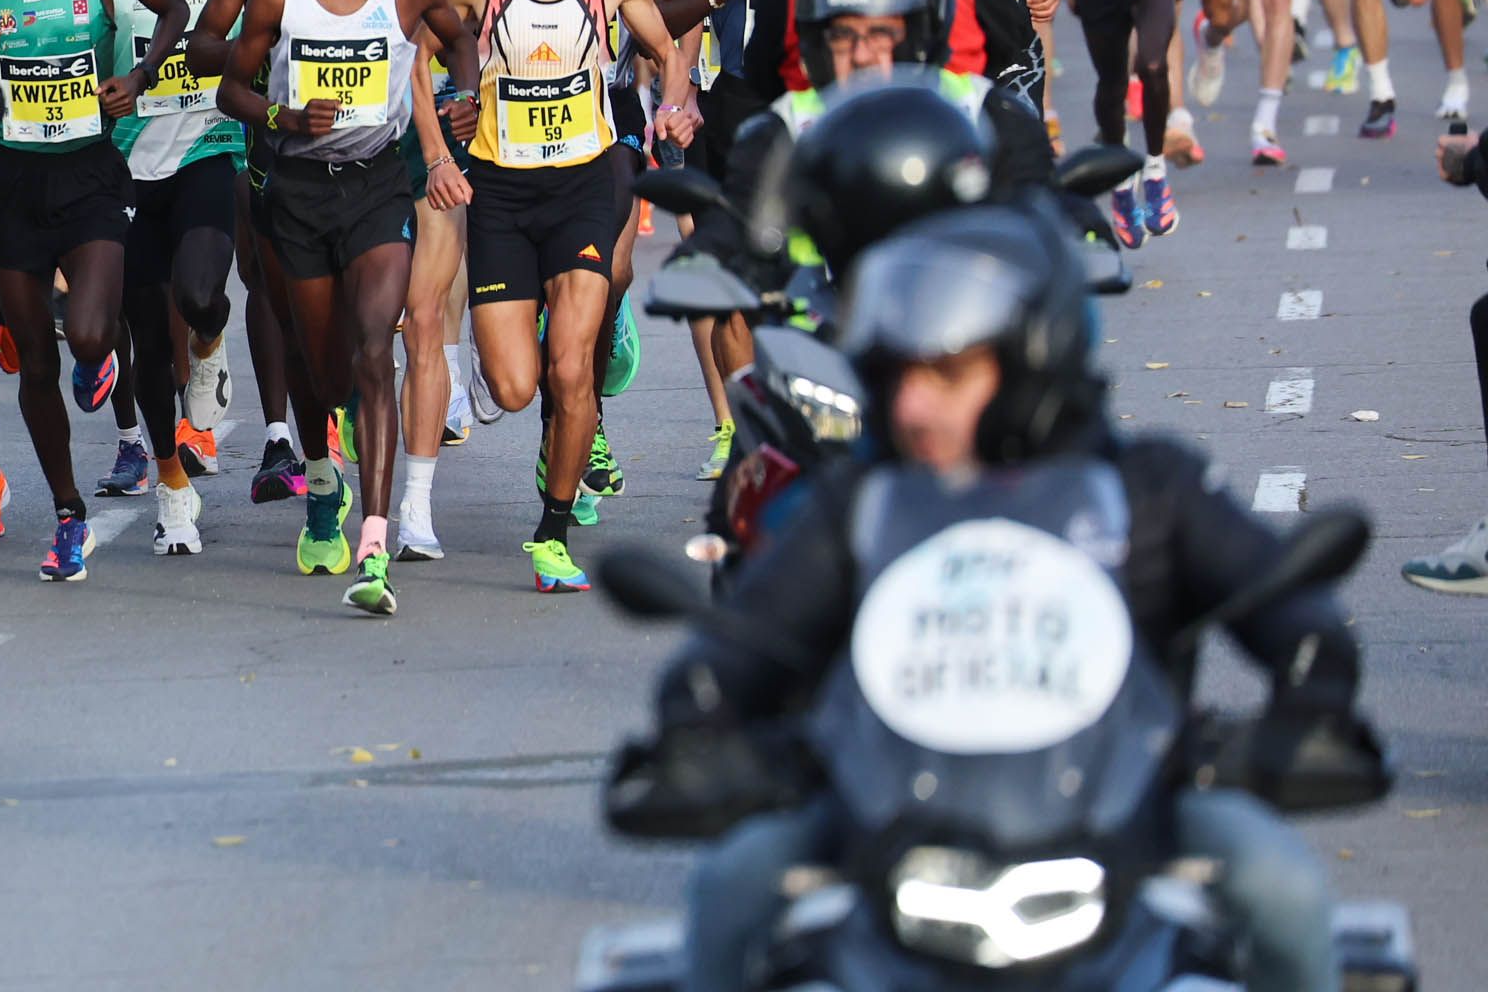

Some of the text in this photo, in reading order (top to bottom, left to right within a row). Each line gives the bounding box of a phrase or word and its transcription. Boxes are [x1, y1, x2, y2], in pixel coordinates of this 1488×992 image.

[301, 44, 354, 60] iberCaja
[9, 64, 60, 78] iberCaja
[317, 67, 372, 88] KROP
[181, 75, 200, 92] 43
[11, 79, 94, 104] KWIZERA
[335, 91, 353, 105] 35
[508, 84, 560, 99] iberCaja
[45, 107, 64, 121] 33
[528, 103, 573, 127] FIFA
[203, 134, 233, 144] REVIER
[545, 126, 563, 141] 59
